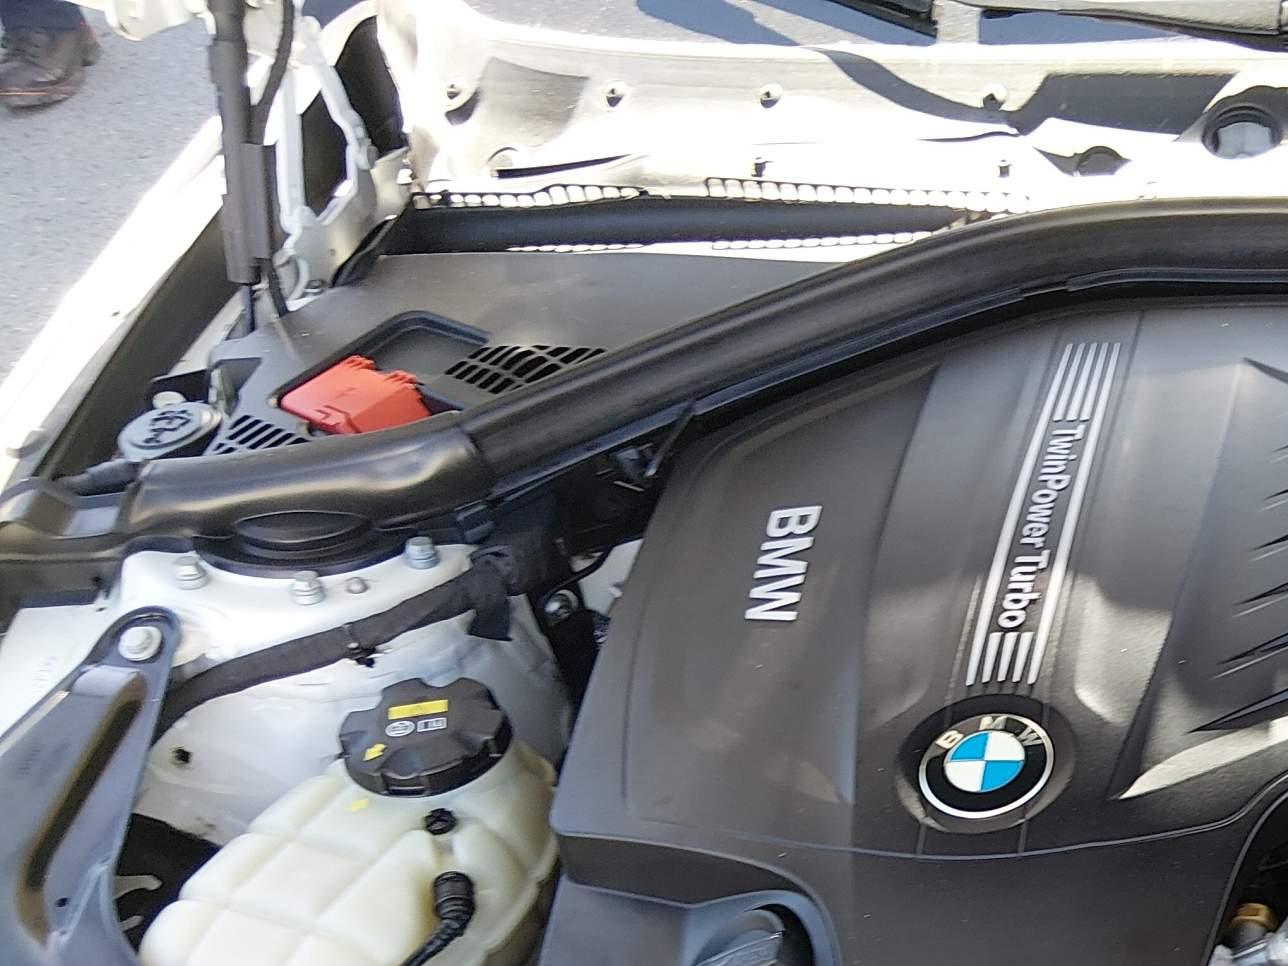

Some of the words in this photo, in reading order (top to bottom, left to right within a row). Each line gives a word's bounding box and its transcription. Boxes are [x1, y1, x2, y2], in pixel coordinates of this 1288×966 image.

[1020, 424, 1086, 549] TwinPower
[744, 505, 823, 621] BMW
[998, 550, 1050, 629] Turbo
[935, 715, 1043, 750] BMW
